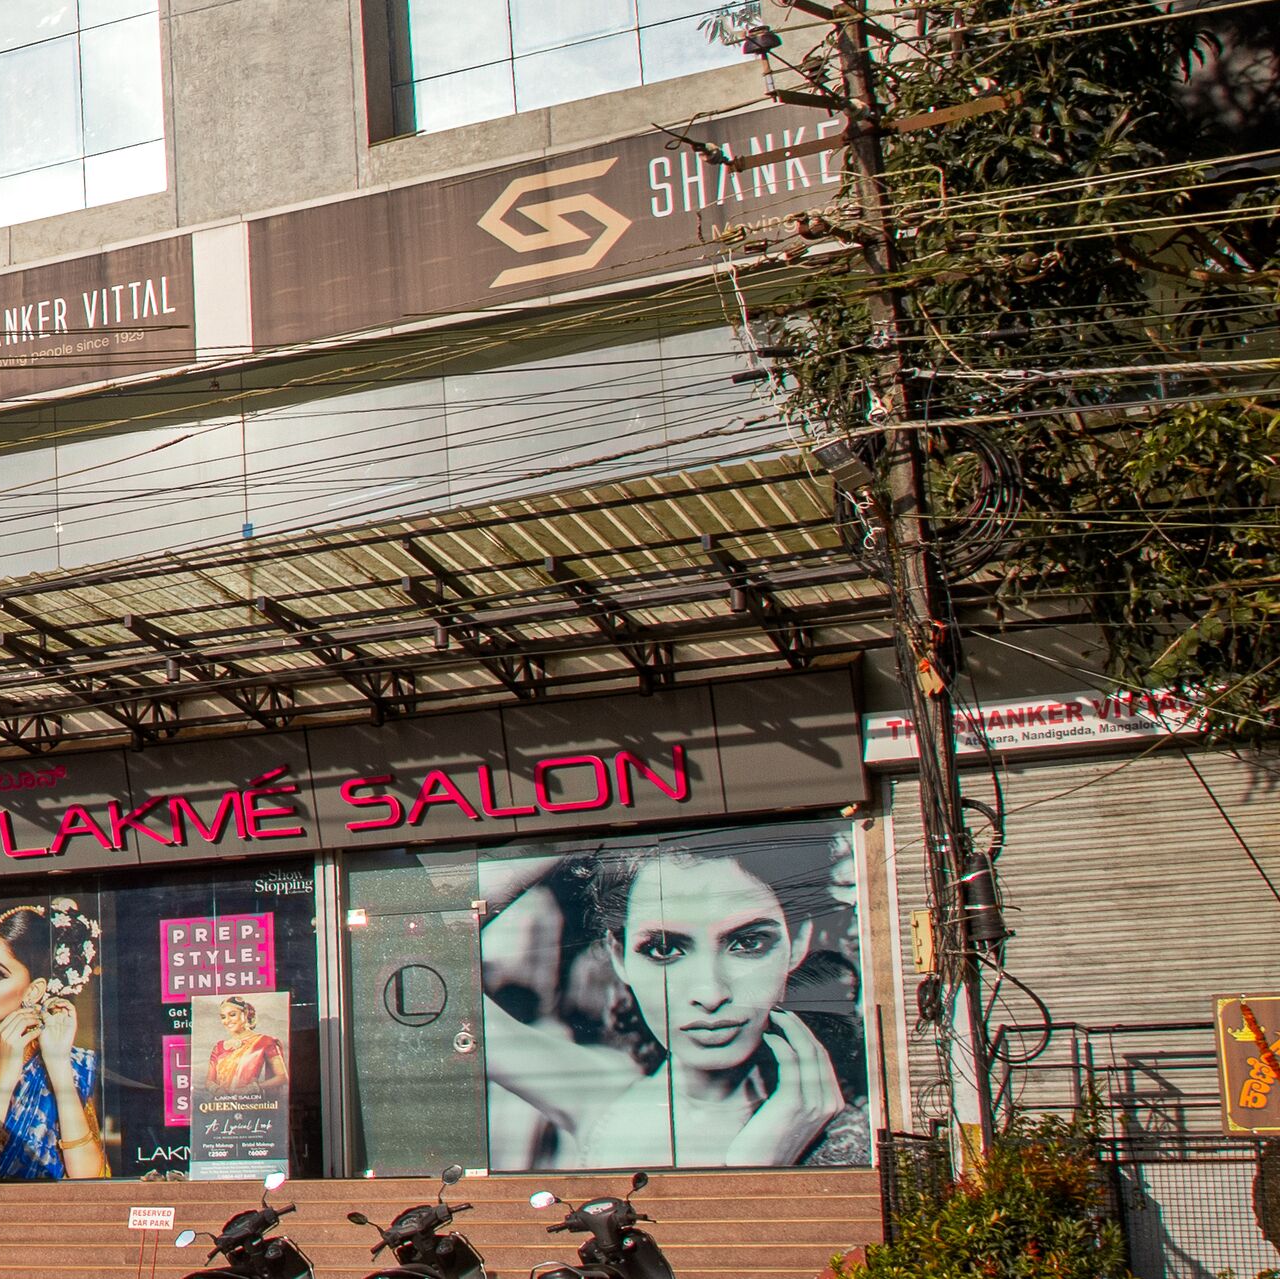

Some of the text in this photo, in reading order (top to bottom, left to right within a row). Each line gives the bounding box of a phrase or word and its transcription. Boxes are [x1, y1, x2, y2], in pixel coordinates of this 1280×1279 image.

[648, 119, 842, 218] SHANKE
[82, 275, 177, 330] VITTAL
[31, 340, 74, 364] people
[76, 334, 111, 353] since
[114, 328, 146, 345] 1929
[953, 700, 1085, 735] SHANKER
[1021, 723, 1096, 745] Nandigudda,
[340, 744, 687, 831] SALON
[254, 879, 313, 895] Stopping
[172, 925, 260, 944] PREP.
[172, 948, 261, 968] STYLE.
[173, 971, 262, 990] FINISH.
[168, 1007, 188, 1018] Get
[199, 1100, 279, 1114] QUEENtessential
[132, 1209, 172, 1217] RESERVED
[132, 1219, 170, 1227] CAR PARK
